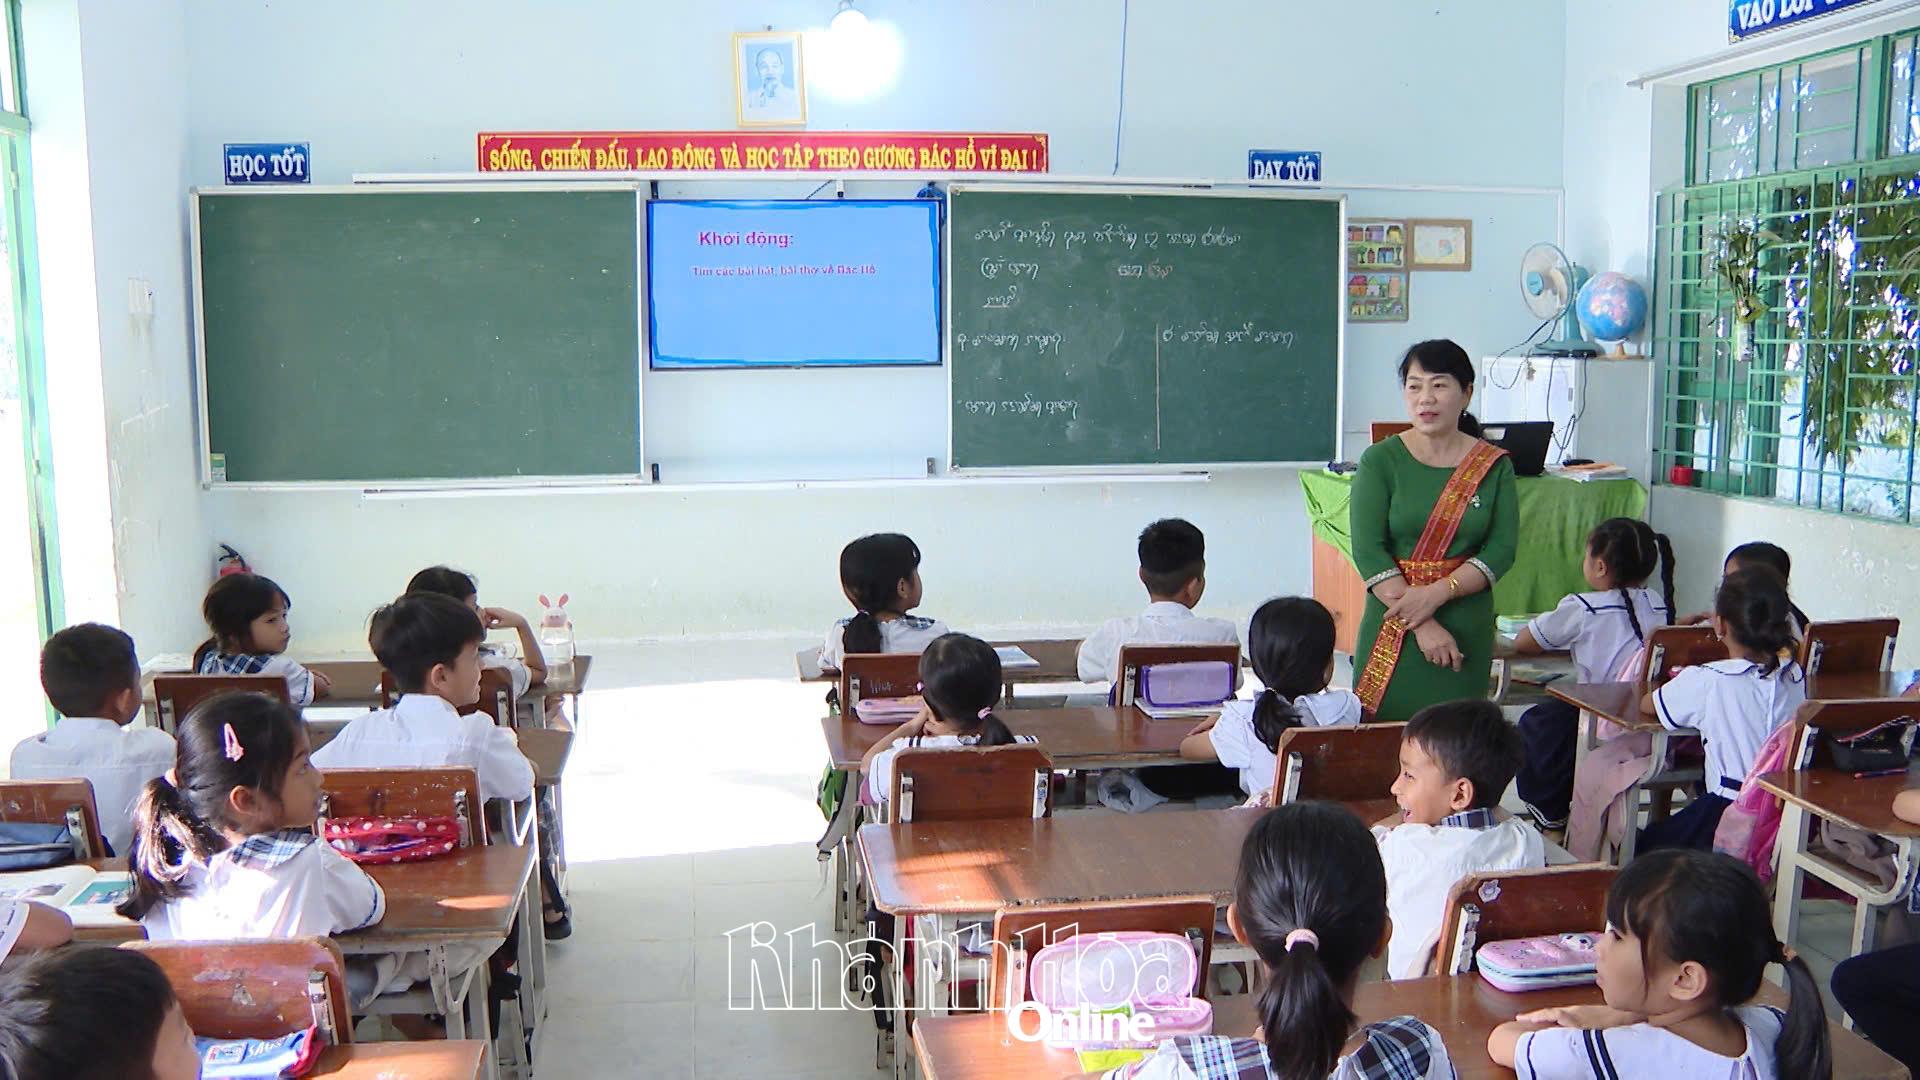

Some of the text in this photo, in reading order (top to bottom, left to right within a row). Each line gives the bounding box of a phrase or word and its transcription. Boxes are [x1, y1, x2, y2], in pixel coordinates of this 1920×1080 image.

[228, 146, 305, 181] HỌC TỐT
[490, 139, 537, 172] SỐNG,
[541, 139, 591, 170] CHIẾN
[596, 139, 632, 172] ĐẤU,
[636, 147, 668, 170] LAO
[672, 143, 716, 172] ĐỘNG
[720, 142, 742, 170] VÀ
[746, 147, 779, 172] HỌC
[783, 142, 815, 171] TẬP
[817, 147, 860, 170] THEO
[864, 144, 916, 170] GƯƠNG
[919, 143, 951, 170] BÁC
[955, 136, 976, 170] HỒ
[980, 143, 999, 170] VĨ
[1001, 149, 1028, 172] ĐẠI
[1287, 155, 1316, 180] TỐT
[699, 231, 794, 248] Khởi động:
